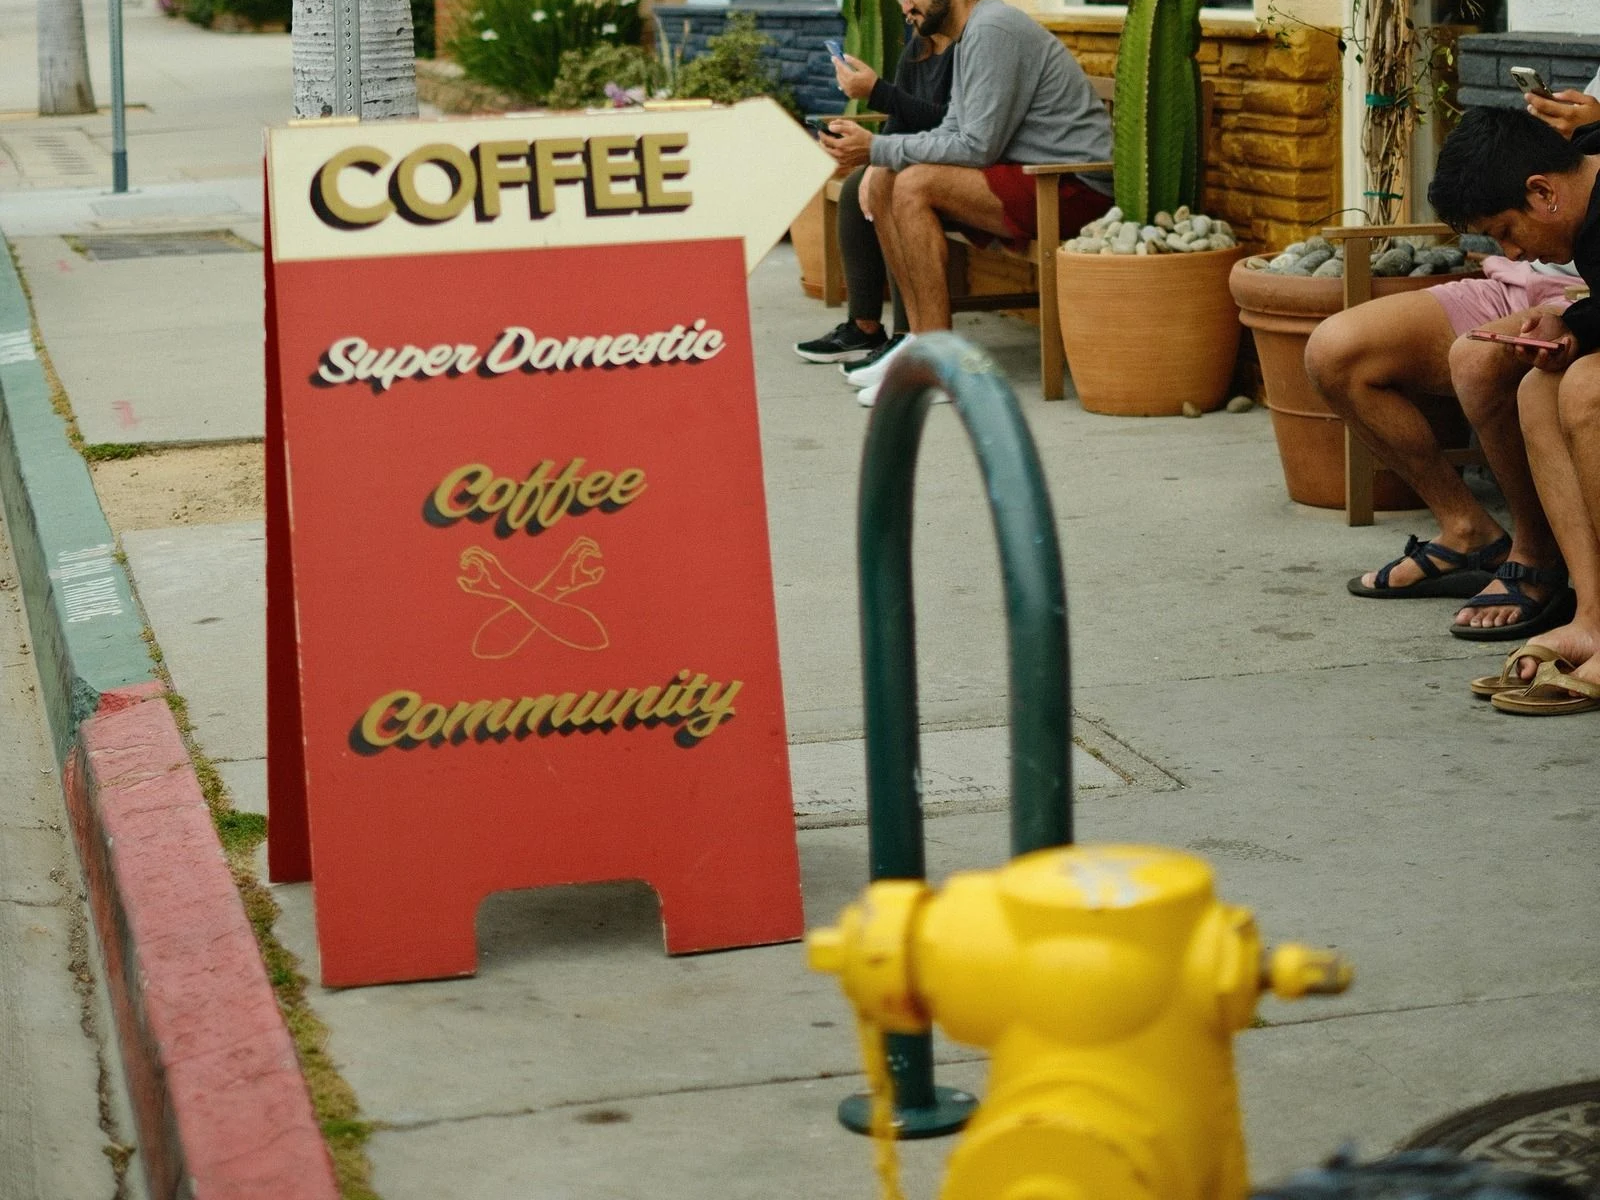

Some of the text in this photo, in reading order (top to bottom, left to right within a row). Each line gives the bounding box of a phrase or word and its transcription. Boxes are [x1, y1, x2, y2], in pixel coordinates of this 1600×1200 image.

[310, 132, 693, 231] COFFEE
[310, 319, 726, 396] Super Domestic
[423, 457, 648, 539] Coffee
[349, 668, 744, 756] Community
